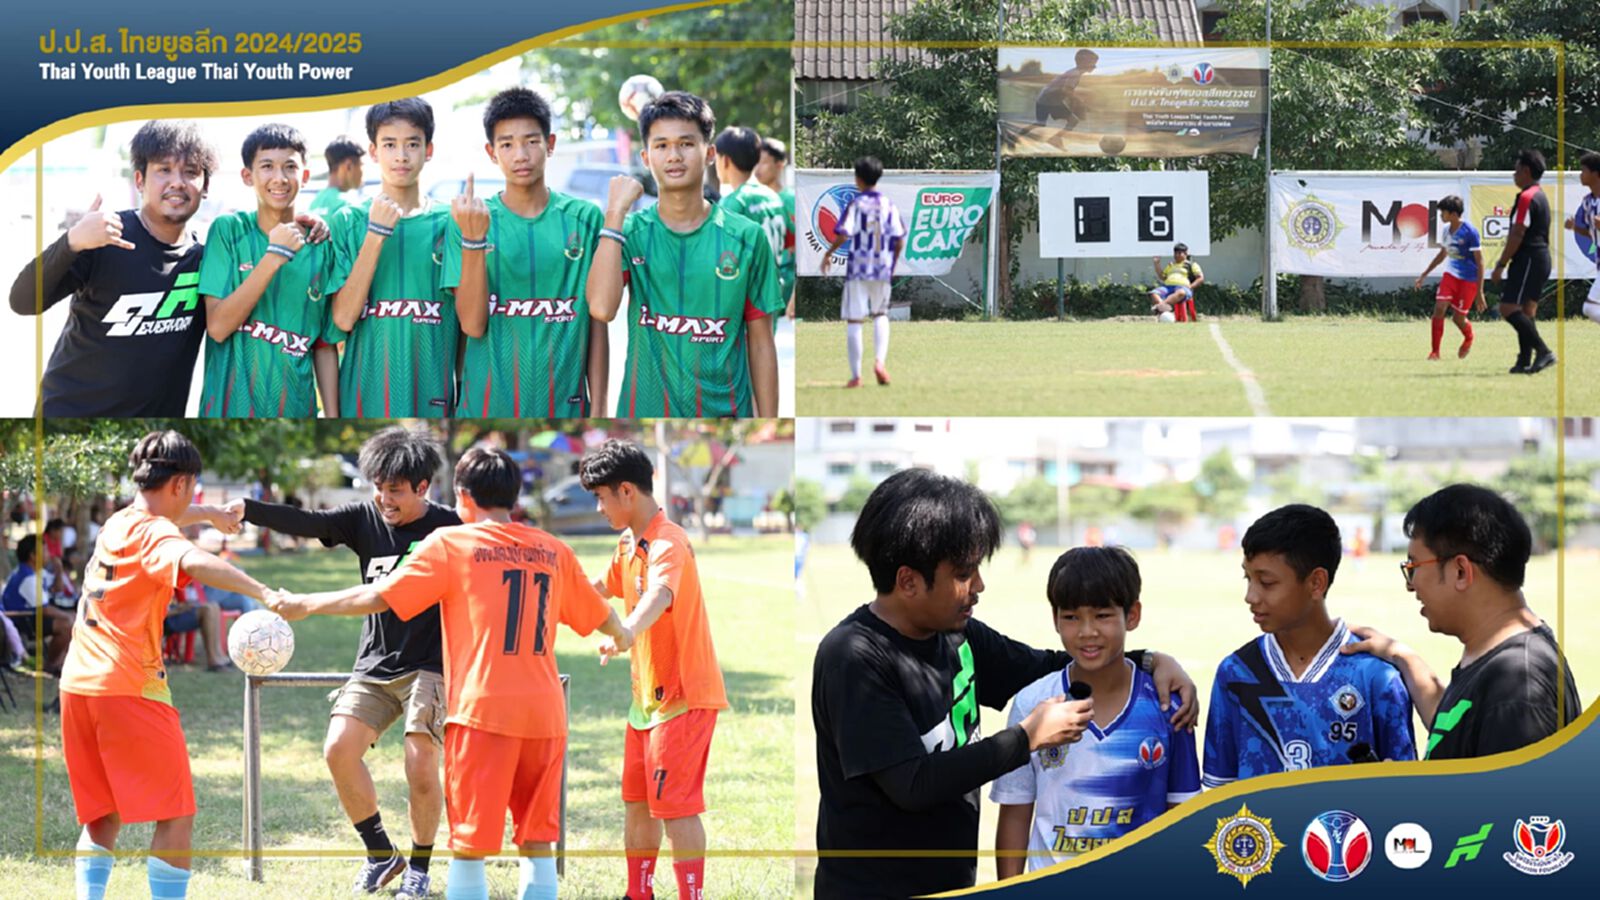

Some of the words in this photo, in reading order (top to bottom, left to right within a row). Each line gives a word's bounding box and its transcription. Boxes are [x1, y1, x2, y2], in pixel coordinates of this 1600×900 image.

[923, 194, 963, 204] EURO
[914, 204, 984, 231] EURO
[1149, 200, 1170, 237] 6
[805, 230, 823, 253] THAI
[639, 304, 730, 336] i-MAX
[238, 320, 310, 353] -MAX
[502, 569, 554, 657] 11
[1328, 721, 1358, 743] 95
[1282, 739, 1313, 772] 3
[653, 769, 667, 800] 7
